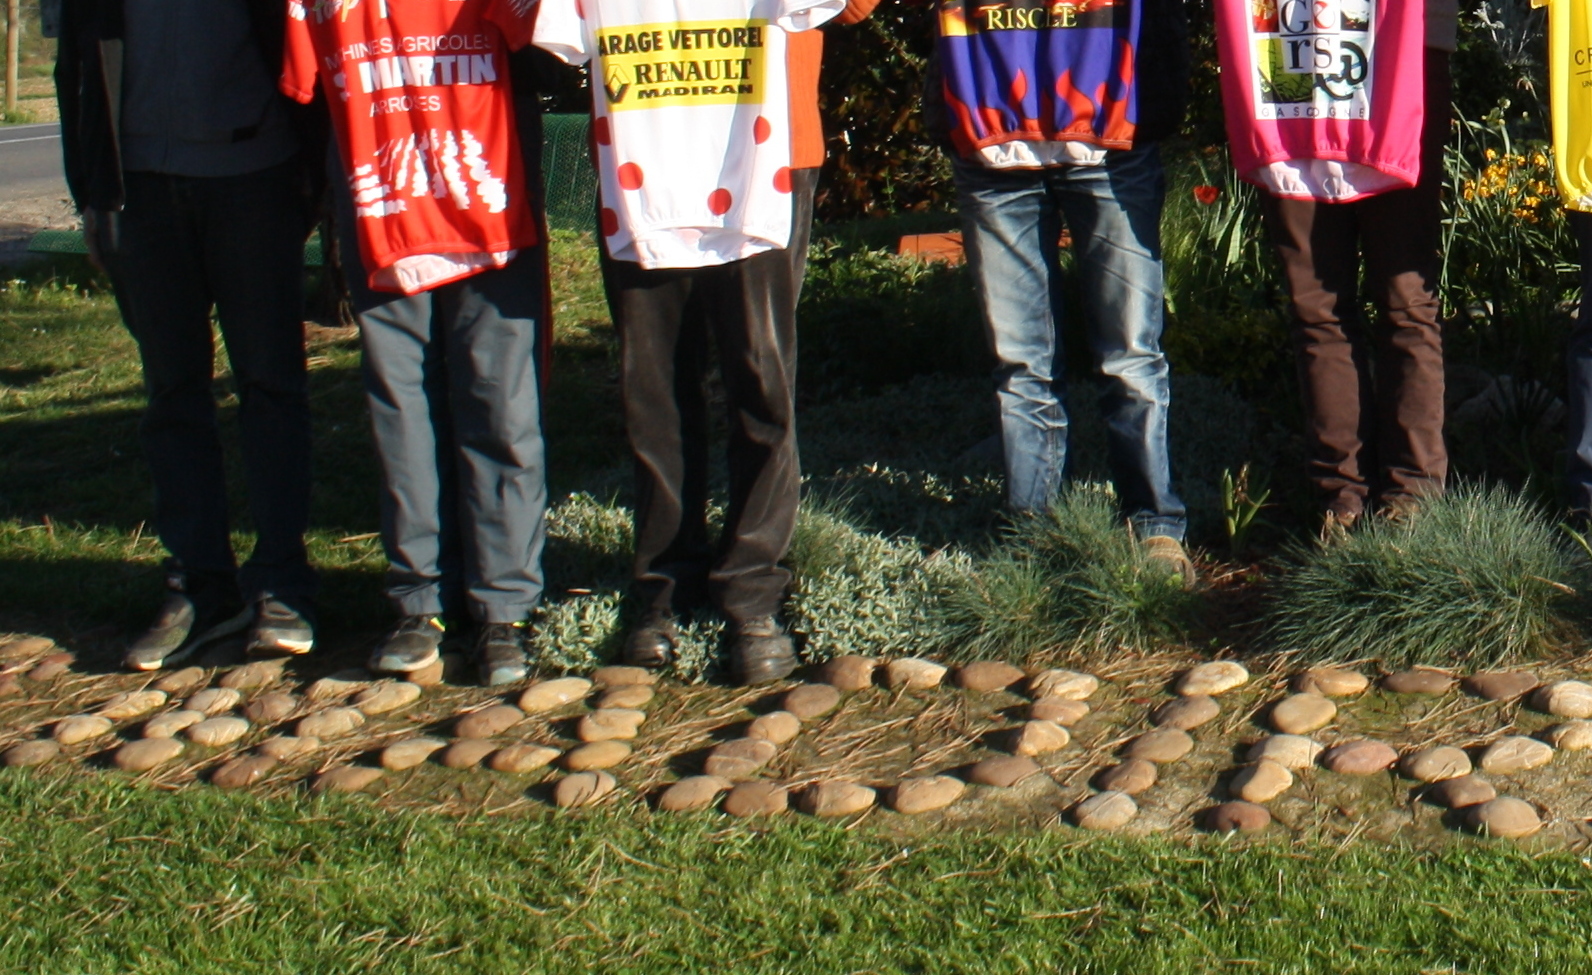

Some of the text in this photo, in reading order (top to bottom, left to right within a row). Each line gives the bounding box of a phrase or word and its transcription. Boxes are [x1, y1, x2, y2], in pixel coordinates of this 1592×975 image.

[325, 34, 492, 71] MHINES GRICOLES
[598, 31, 664, 57] ARAGE
[358, 53, 497, 94] MARTIN
[633, 58, 752, 86] RENAULT
[637, 84, 754, 100] MADIRAN
